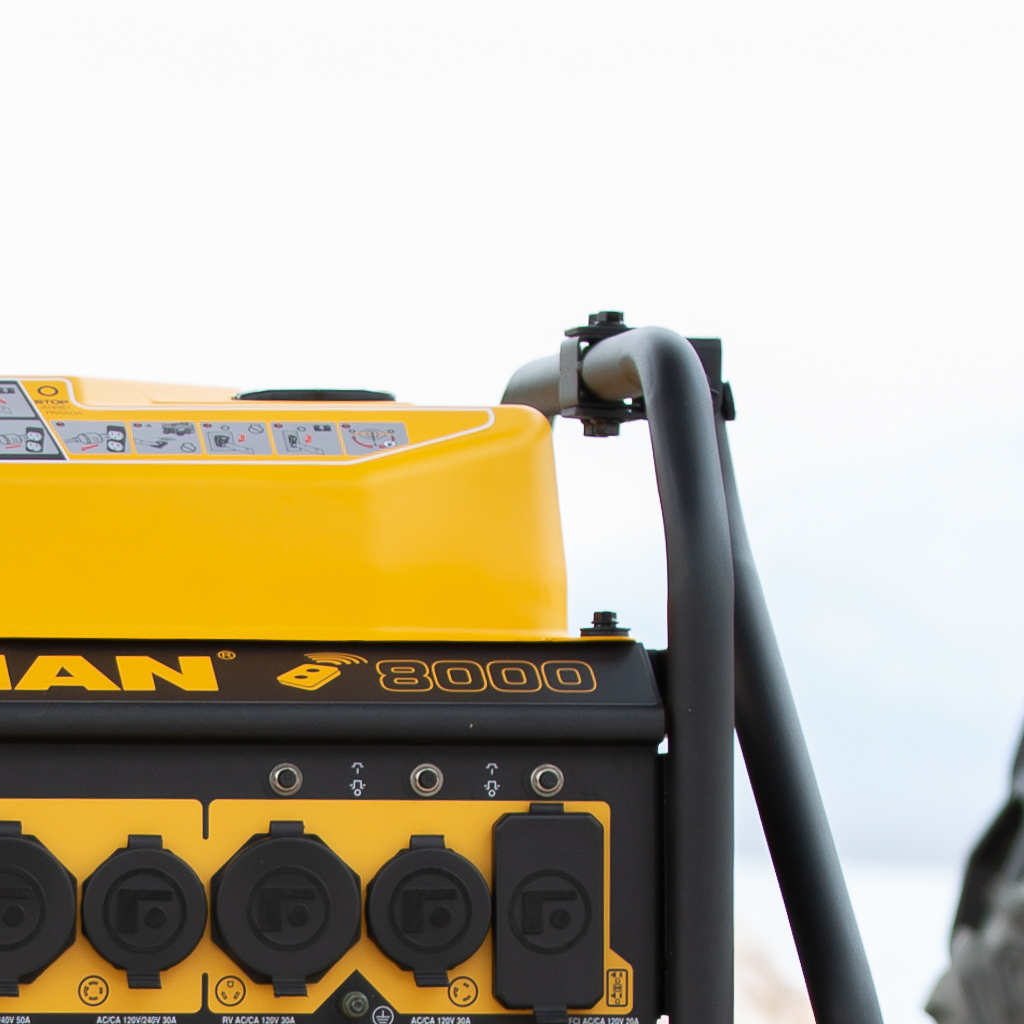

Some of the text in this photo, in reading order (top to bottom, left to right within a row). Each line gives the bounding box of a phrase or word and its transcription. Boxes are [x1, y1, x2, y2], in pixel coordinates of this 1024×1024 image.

[376, 659, 597, 692] 8000
[16, 1015, 31, 1024] 50A
[96, 1015, 121, 1024] AC/CA
[162, 1015, 177, 1024] 30A
[222, 1016, 296, 1024] RV AC/CA 120V 30A
[411, 1016, 471, 1024] AC/CA 120V 30A
